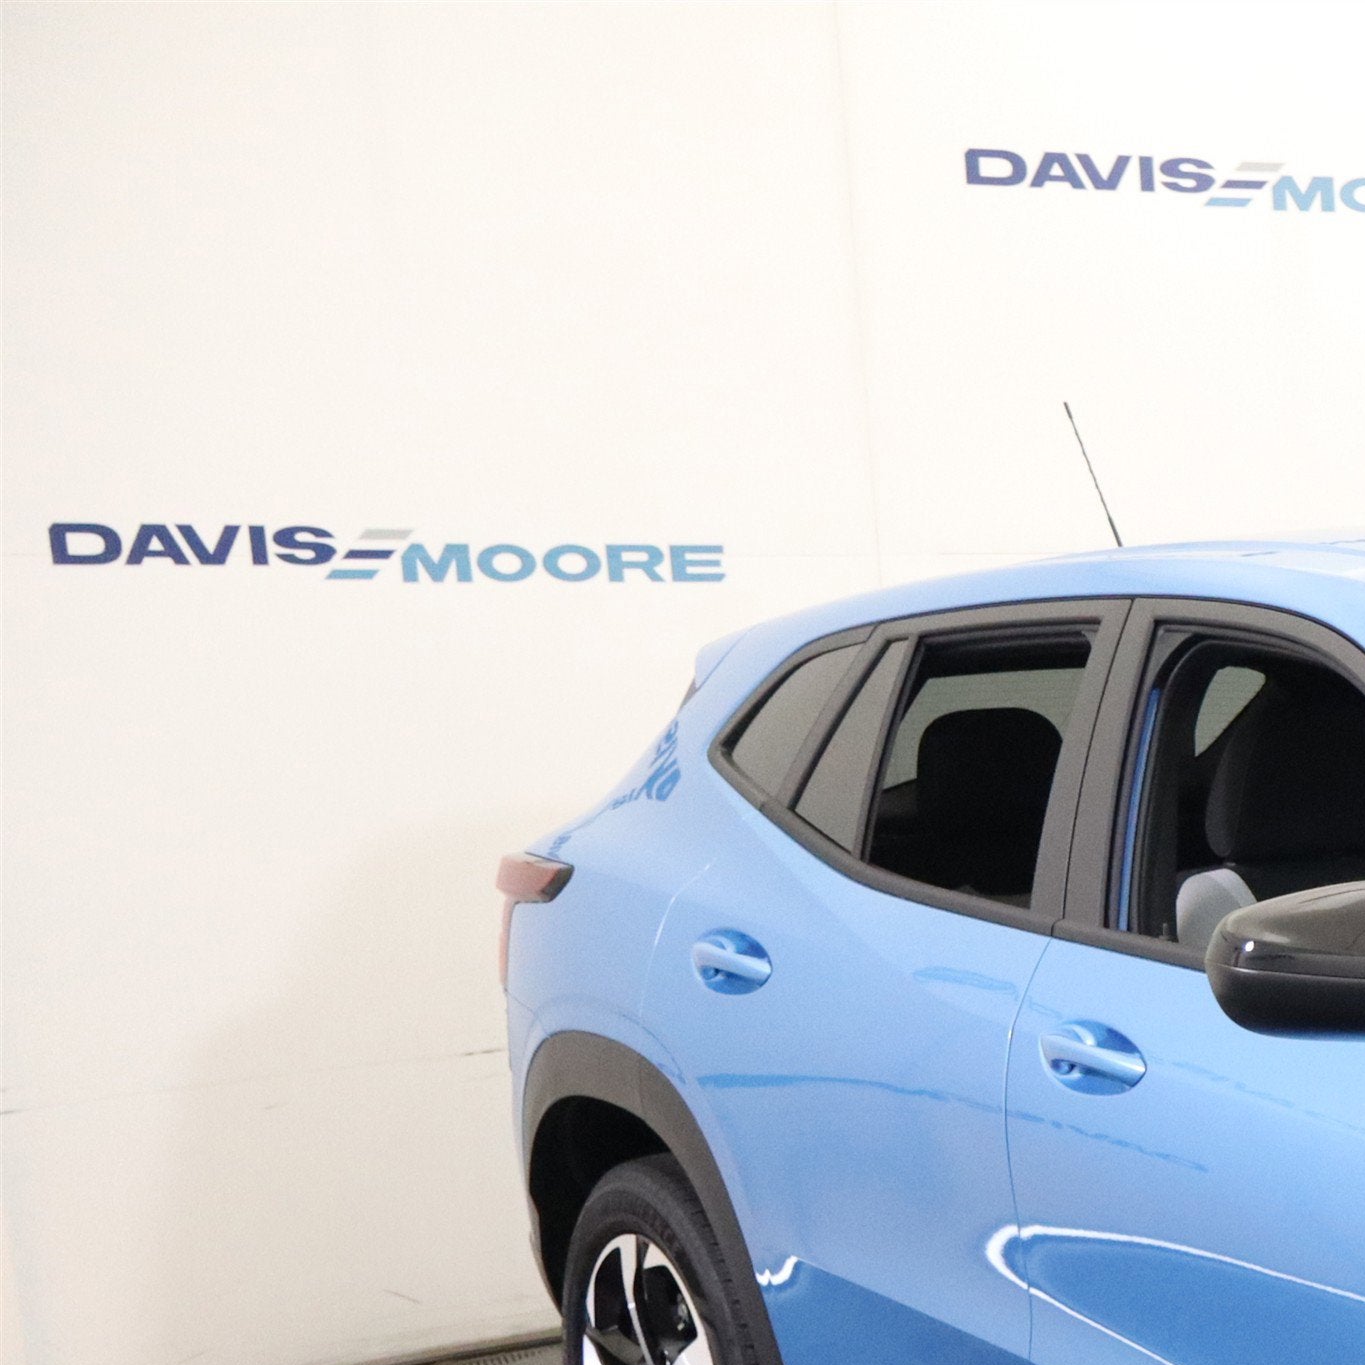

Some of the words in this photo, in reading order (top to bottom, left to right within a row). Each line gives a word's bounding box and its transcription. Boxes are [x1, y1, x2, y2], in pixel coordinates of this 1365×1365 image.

[965, 148, 1215, 193] DAVIS
[49, 522, 338, 566] DAVIS
[401, 542, 727, 583] MOORE
